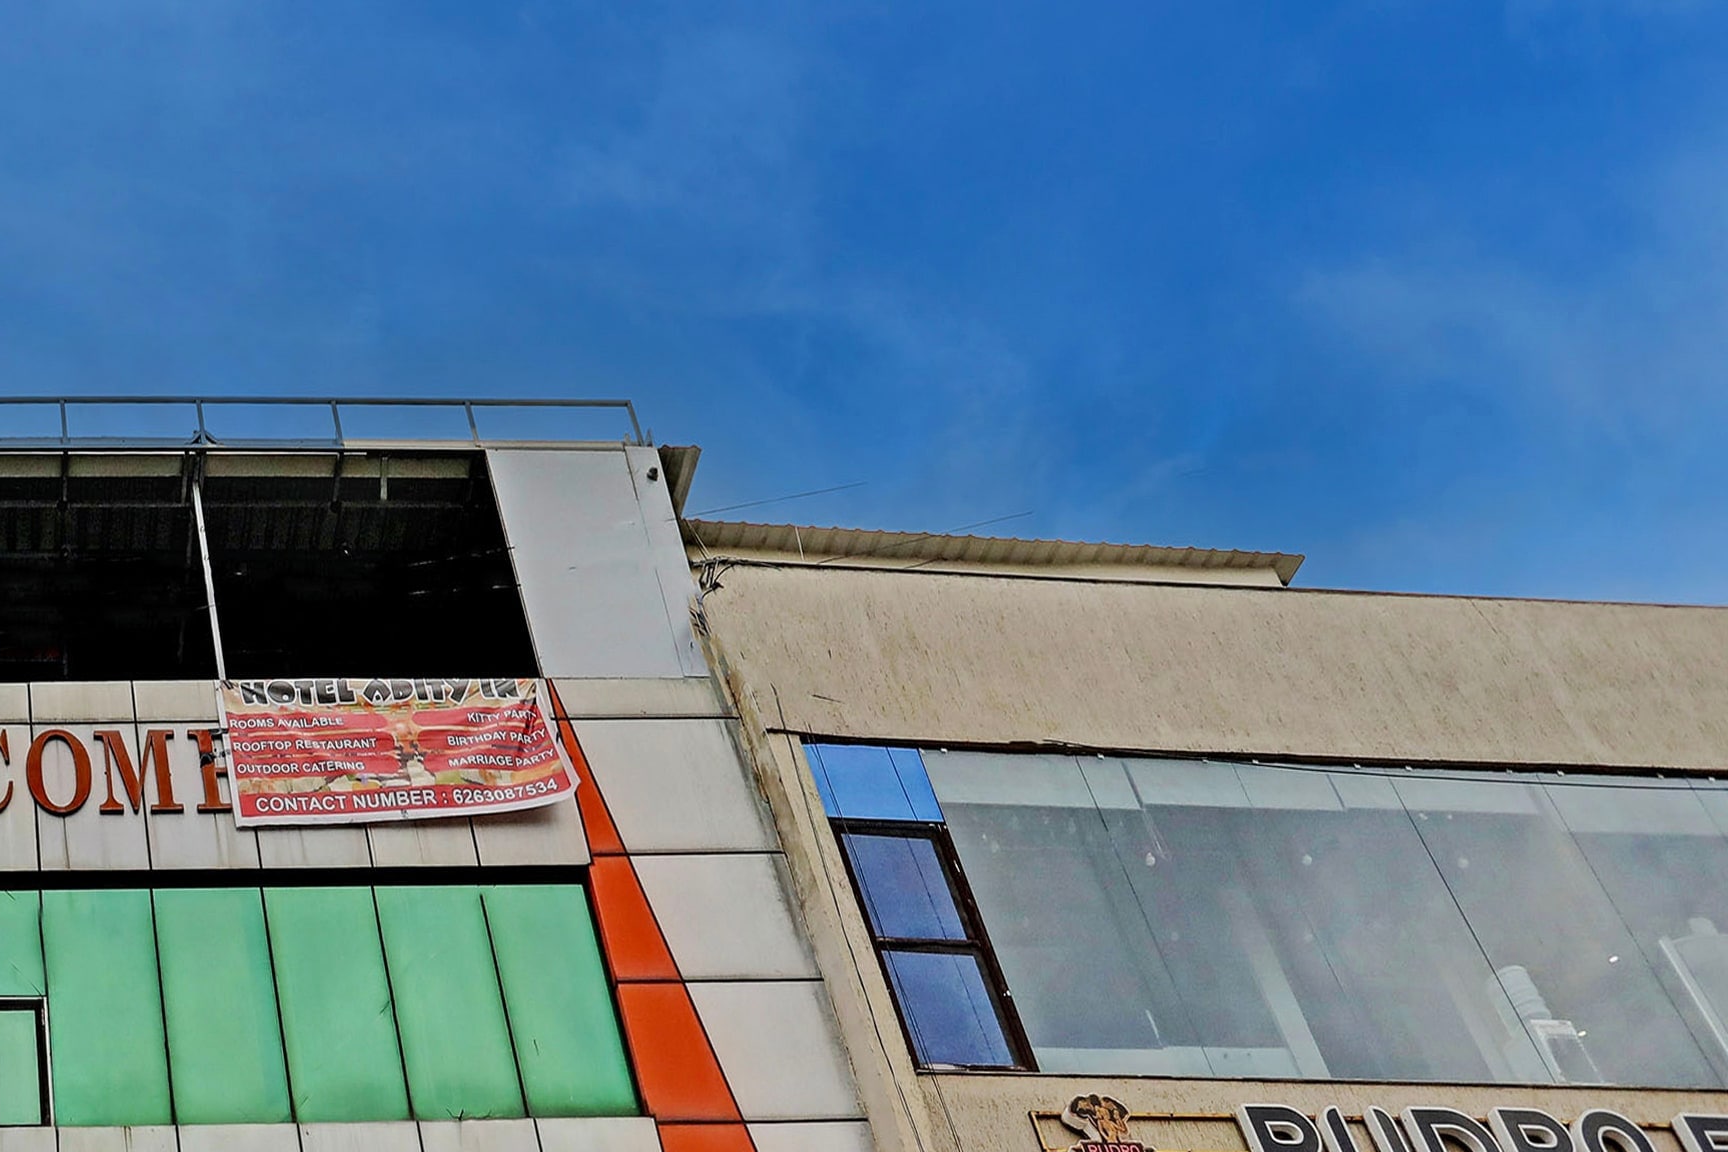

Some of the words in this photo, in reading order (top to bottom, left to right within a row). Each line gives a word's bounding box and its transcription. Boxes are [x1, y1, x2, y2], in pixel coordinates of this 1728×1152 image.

[240, 679, 357, 705] HOTEL
[229, 718, 274, 729] ROOMS
[278, 717, 344, 729] AVAILABLE
[467, 712, 500, 723] KITTY
[233, 740, 292, 752] ROOFTOP
[295, 738, 377, 750] RESTAURANT
[447, 731, 507, 746] BIRTHDAY
[510, 728, 546, 745] PARTY
[448, 754, 514, 767] MARRIAGE
[515, 748, 555, 767] PARTY
[237, 762, 299, 774] OUTDOOR
[302, 761, 365, 773] CATERING
[255, 795, 347, 813] CONTACT
[352, 789, 438, 809] NUMBER
[452, 778, 559, 805] 6263087534
